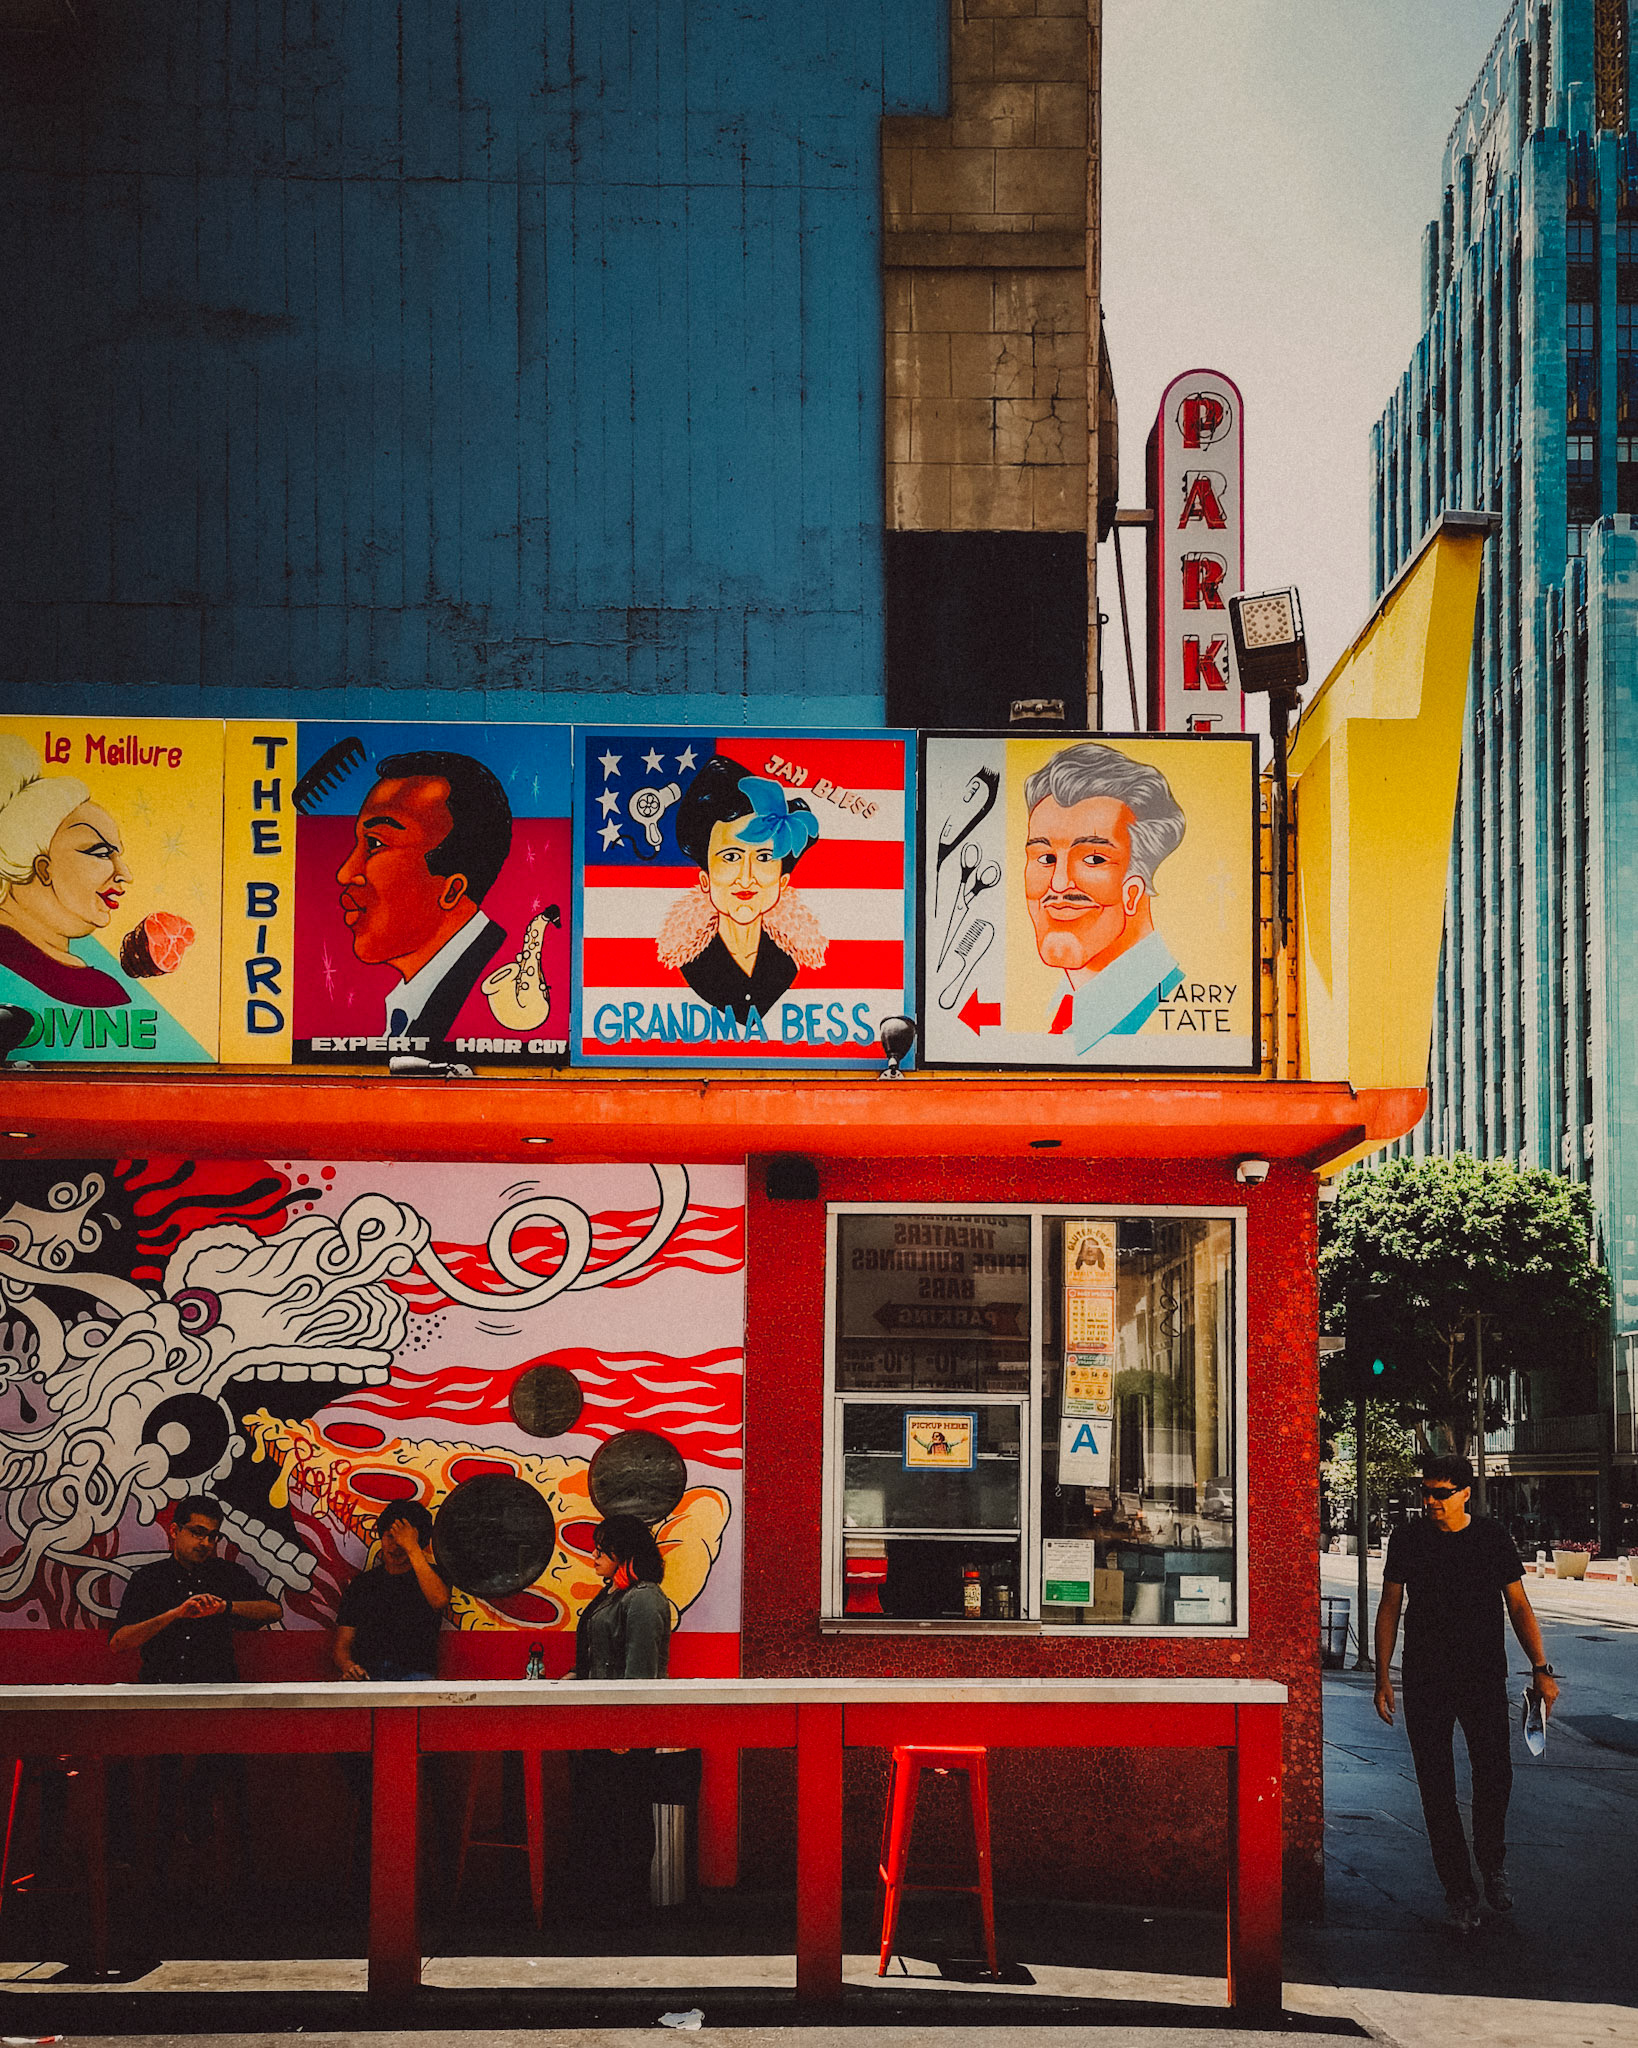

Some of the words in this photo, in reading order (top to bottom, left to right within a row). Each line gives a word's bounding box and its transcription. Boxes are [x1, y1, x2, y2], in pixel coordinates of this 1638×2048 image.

[1177, 391, 1232, 732] PARK
[45, 731, 71, 764] Le
[251, 735, 289, 856] THE
[764, 754, 809, 787] JAH
[811, 778, 880, 819] BLESS
[245, 881, 286, 1036] BIRD
[1158, 982, 1237, 1004] LARRY
[593, 1002, 768, 1046] GRANDMA
[782, 1002, 875, 1046] BESS
[1158, 1008, 1231, 1032] TATE
[311, 1036, 431, 1052] EXPERT
[455, 1037, 522, 1054] HAIR
[527, 1038, 567, 1055] CUT
[911, 1422, 943, 1430] PICKUP
[1070, 1424, 1099, 1455] A
